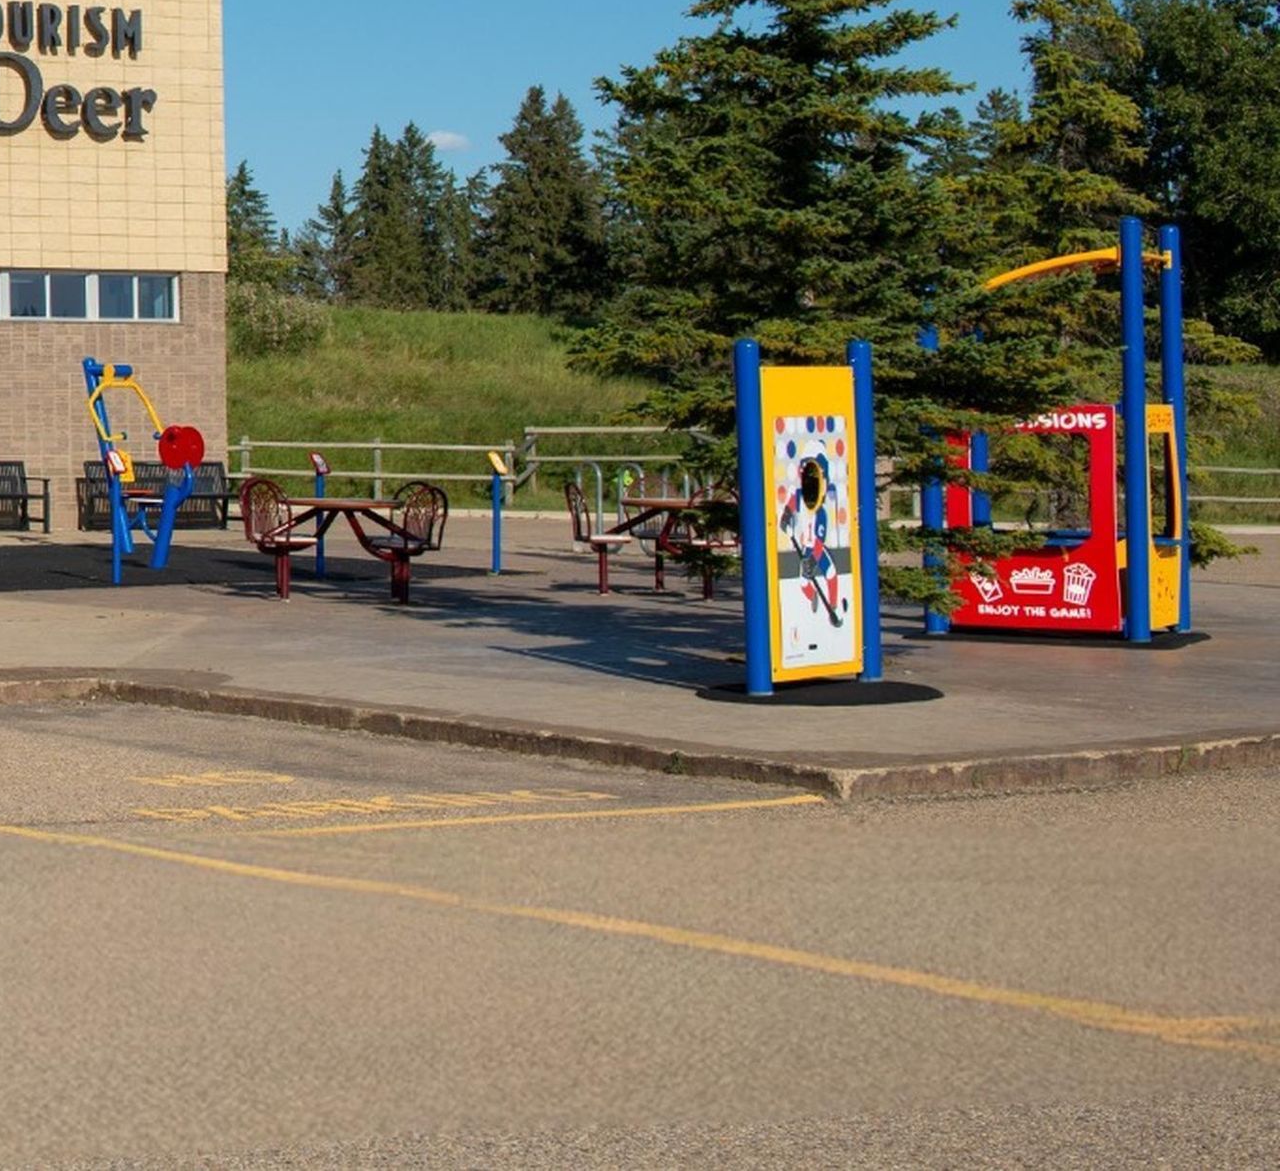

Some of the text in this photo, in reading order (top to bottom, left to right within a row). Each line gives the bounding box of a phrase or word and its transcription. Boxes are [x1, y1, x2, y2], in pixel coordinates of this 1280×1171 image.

[978, 604, 1092, 619] ENJOY THE GAME!
